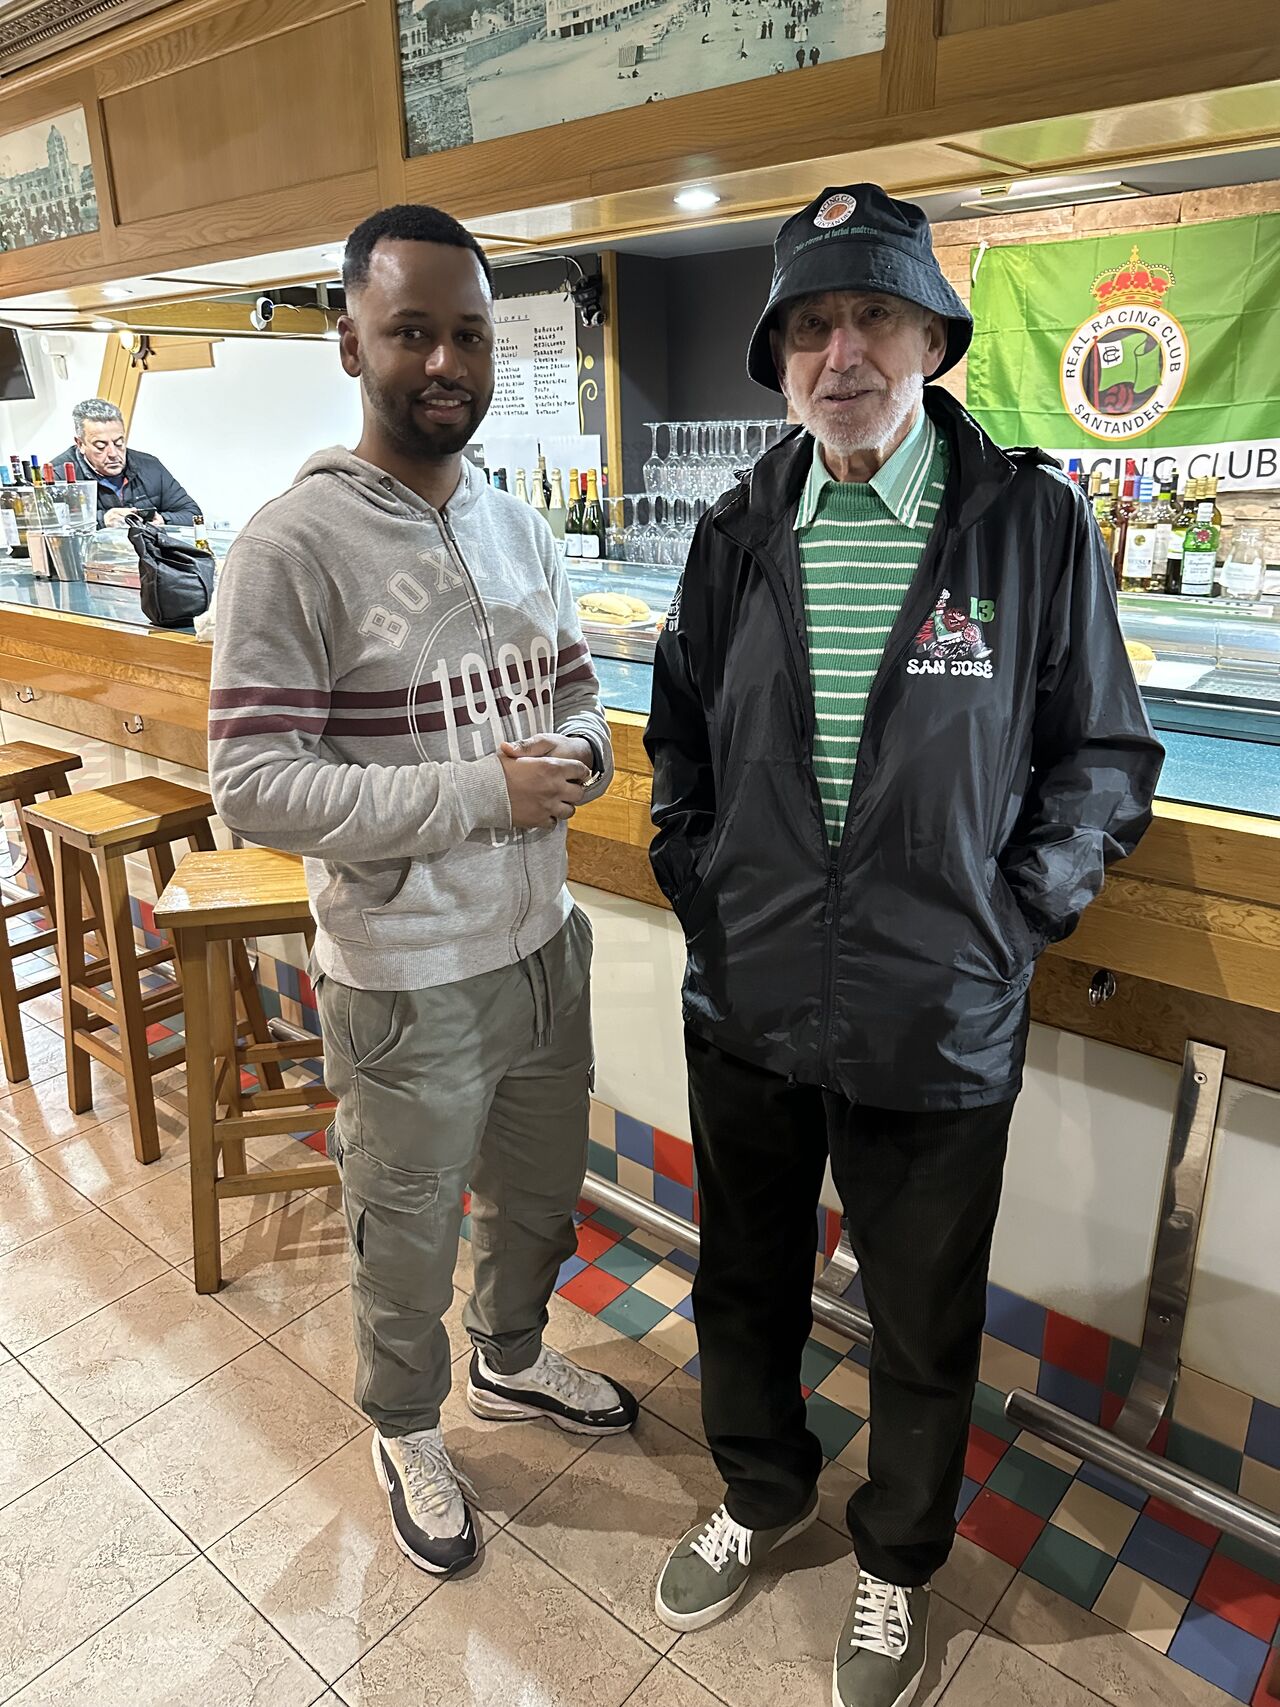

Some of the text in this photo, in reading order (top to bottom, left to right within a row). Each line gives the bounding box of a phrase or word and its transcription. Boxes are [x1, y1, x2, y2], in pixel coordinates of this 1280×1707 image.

[1065, 335, 1092, 378] REAL
[1091, 310, 1160, 334] RACING
[1161, 326, 1181, 373] CLUB
[1074, 400, 1165, 434] SANTANDER
[1058, 448, 1278, 485] CING CLUB
[969, 596, 995, 623] 13
[906, 659, 946, 675] SAN
